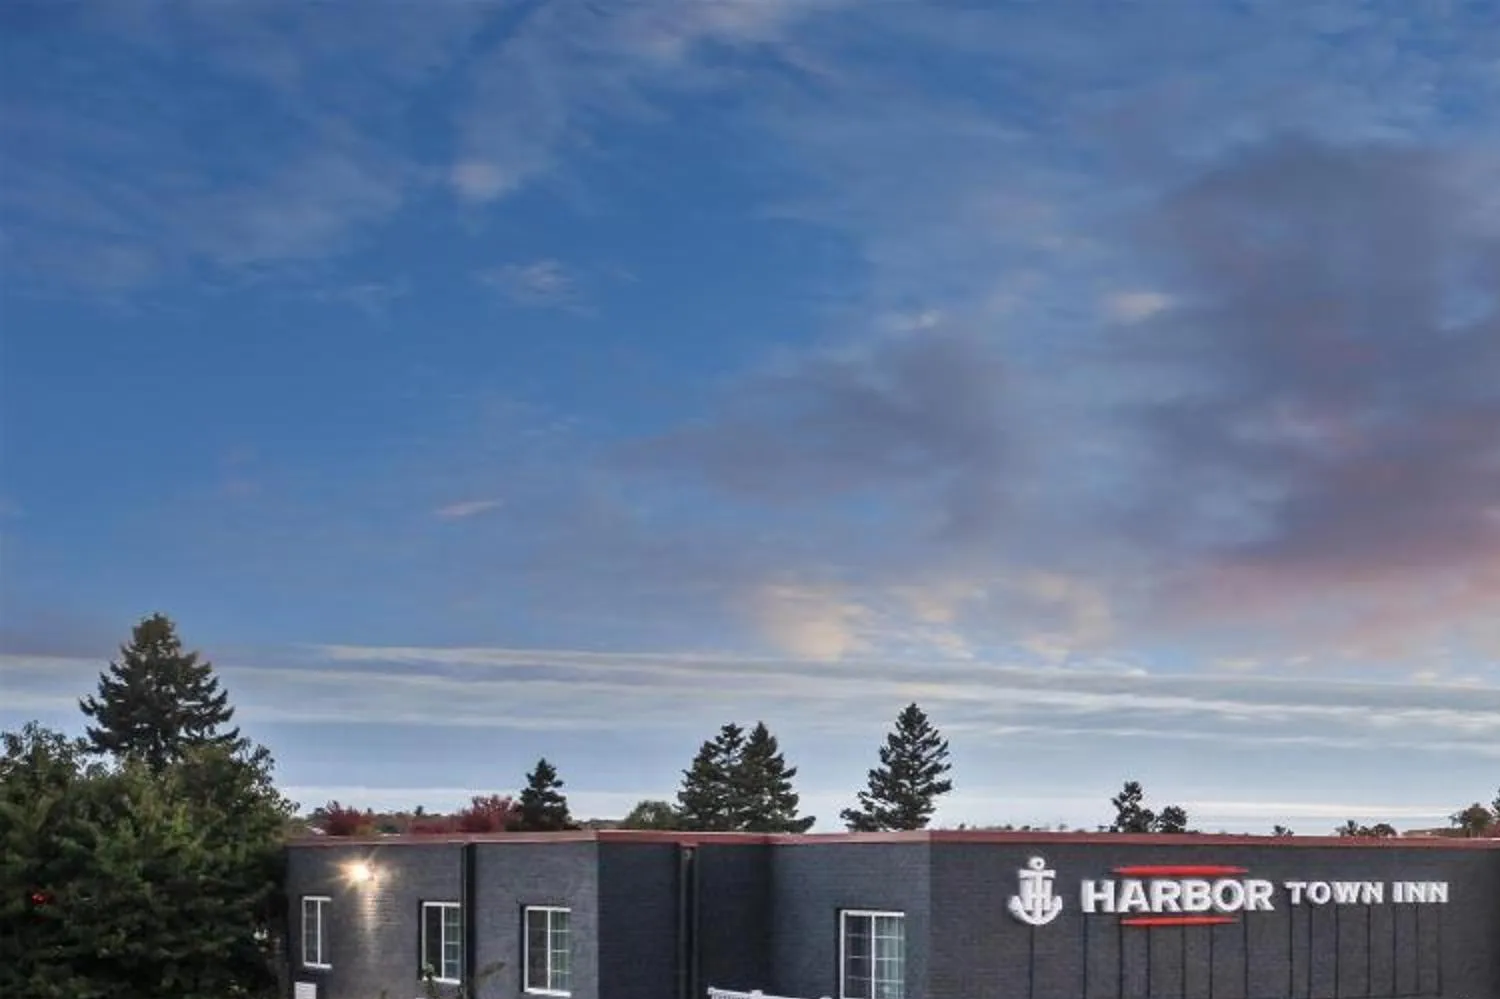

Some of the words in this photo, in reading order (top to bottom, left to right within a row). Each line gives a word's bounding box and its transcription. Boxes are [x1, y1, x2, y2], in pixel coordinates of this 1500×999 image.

[1081, 878, 1275, 914] HARBOR
[1284, 880, 1384, 905] TOWN
[1392, 881, 1449, 903] INN
